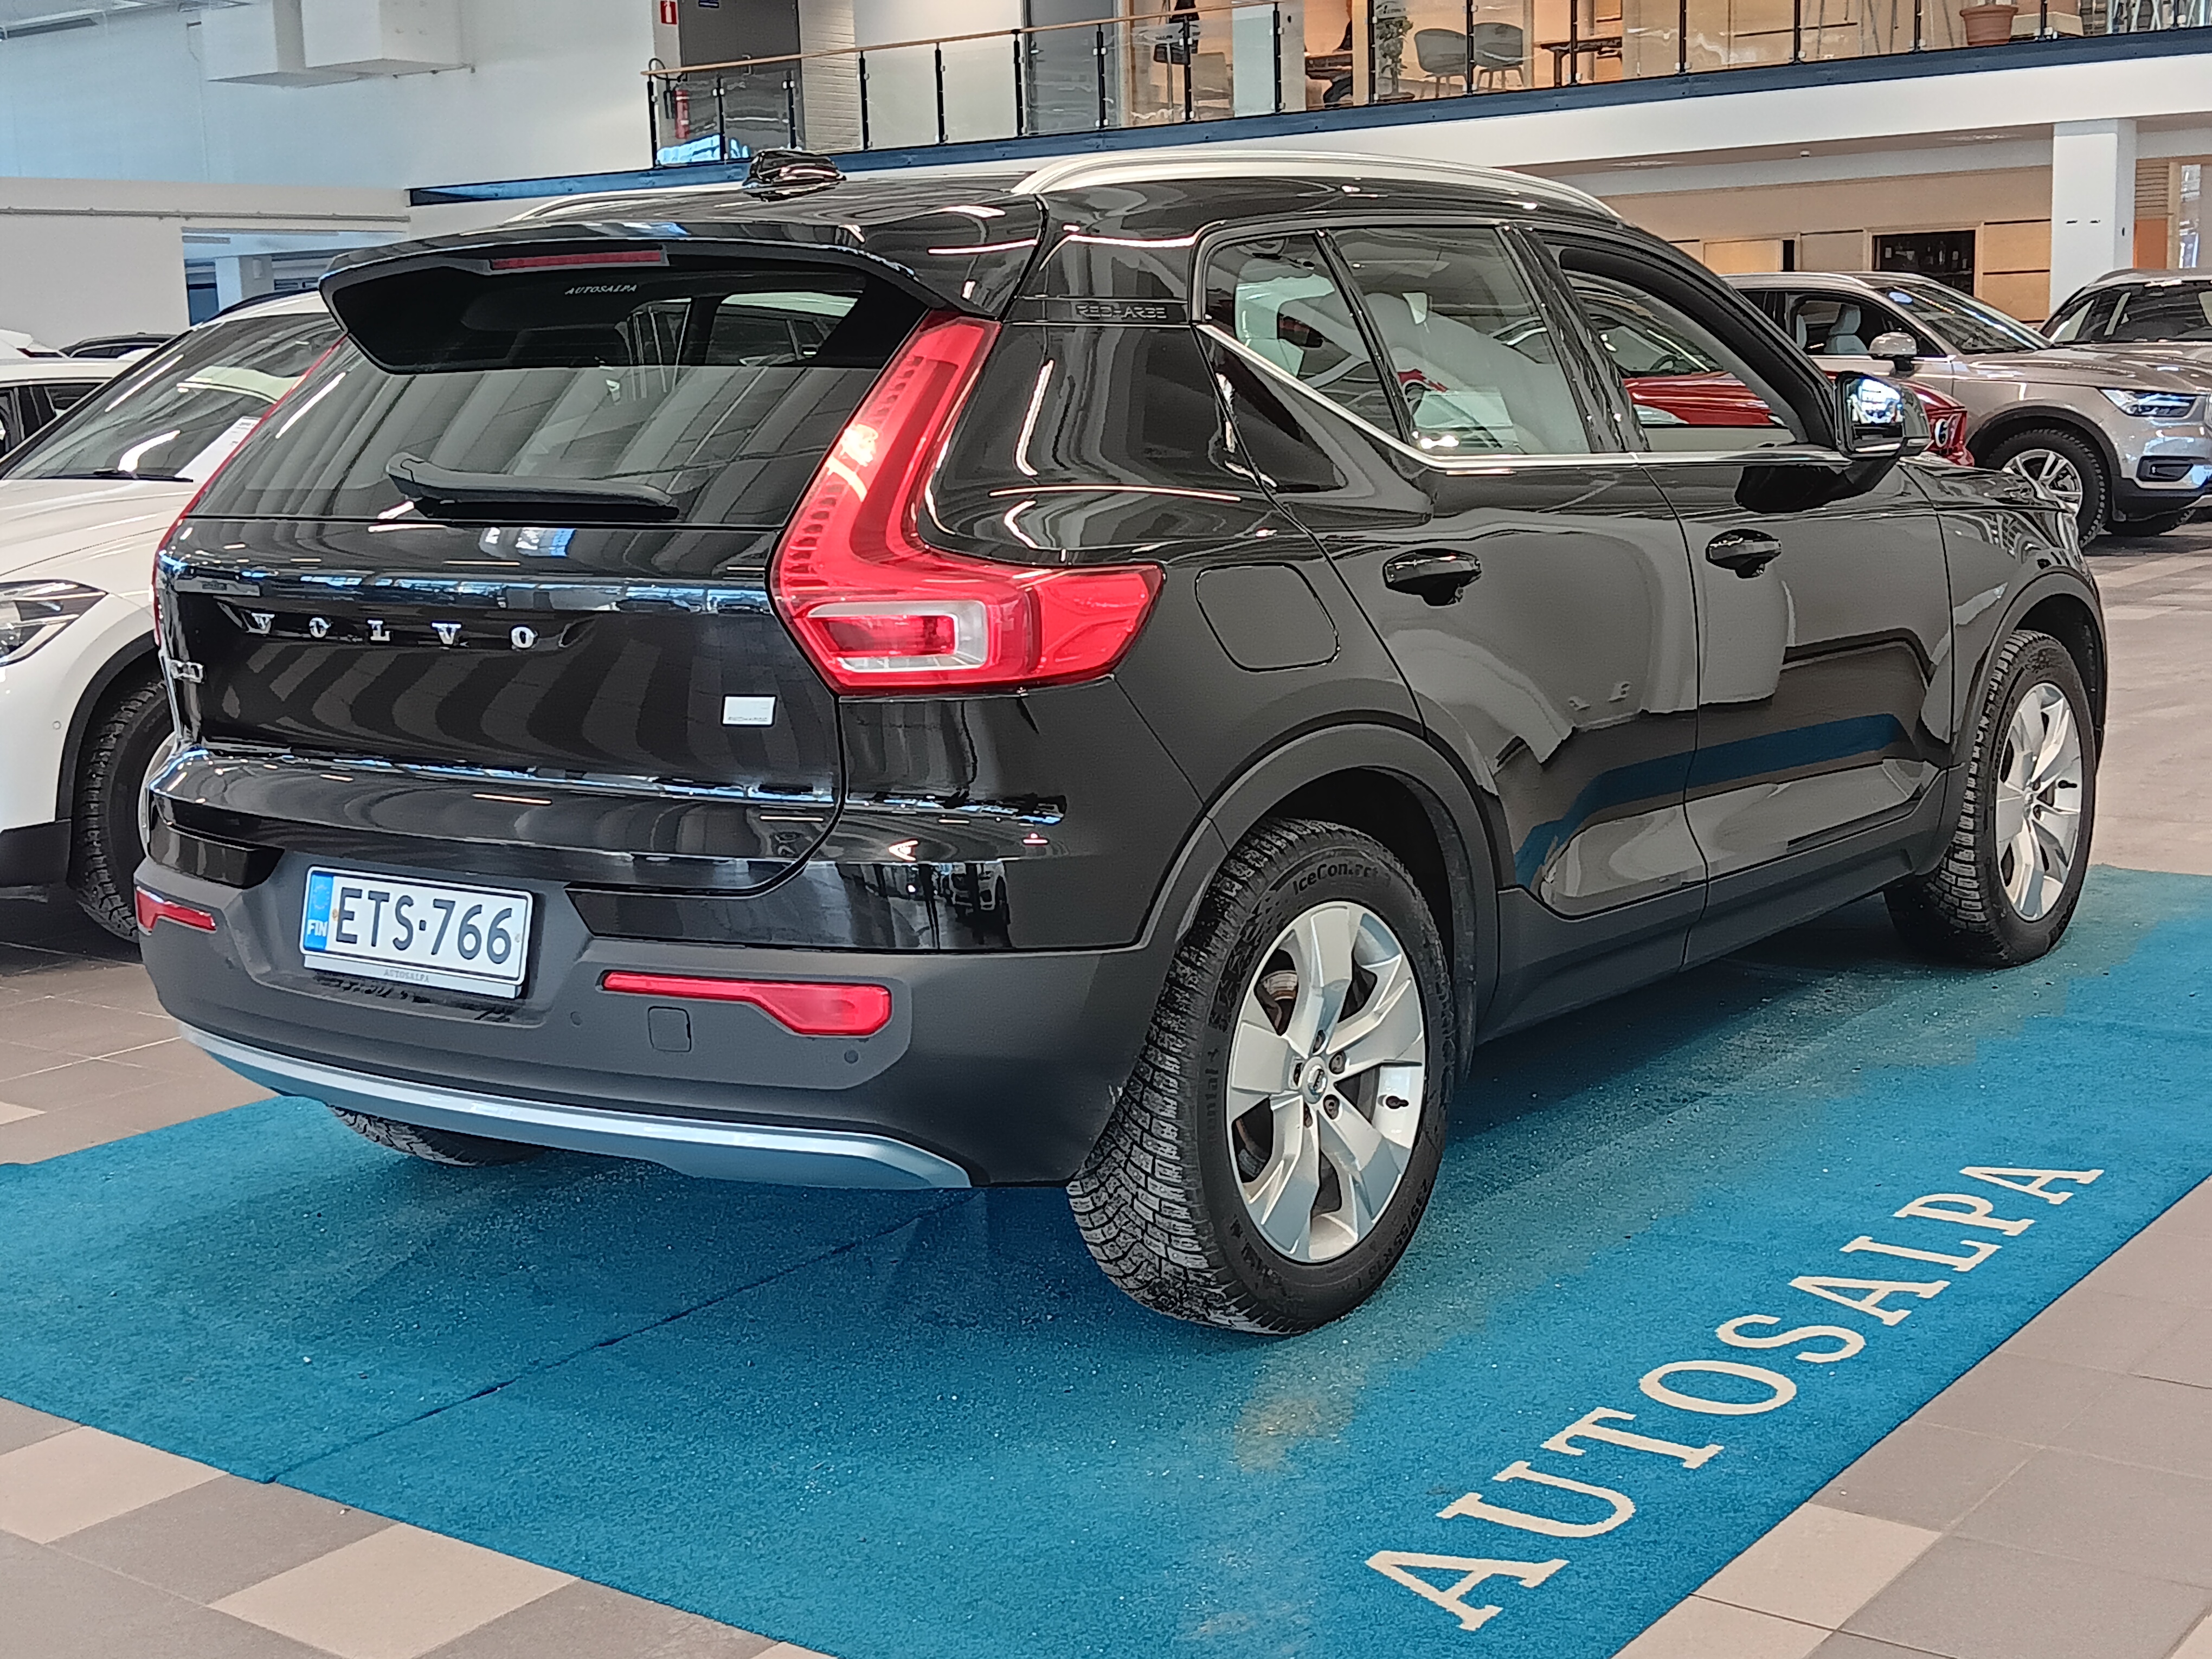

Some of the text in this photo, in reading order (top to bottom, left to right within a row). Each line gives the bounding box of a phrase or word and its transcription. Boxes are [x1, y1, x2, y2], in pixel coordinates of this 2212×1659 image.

[564, 284, 637, 295] AUTOSALPA
[250, 612, 539, 649] VOLVO
[306, 919, 328, 937] FIN
[336, 886, 513, 964] ETS-766
[383, 968, 430, 983] AUTOSALPA
[1363, 1165, 2105, 1631] AUTOSALPA
